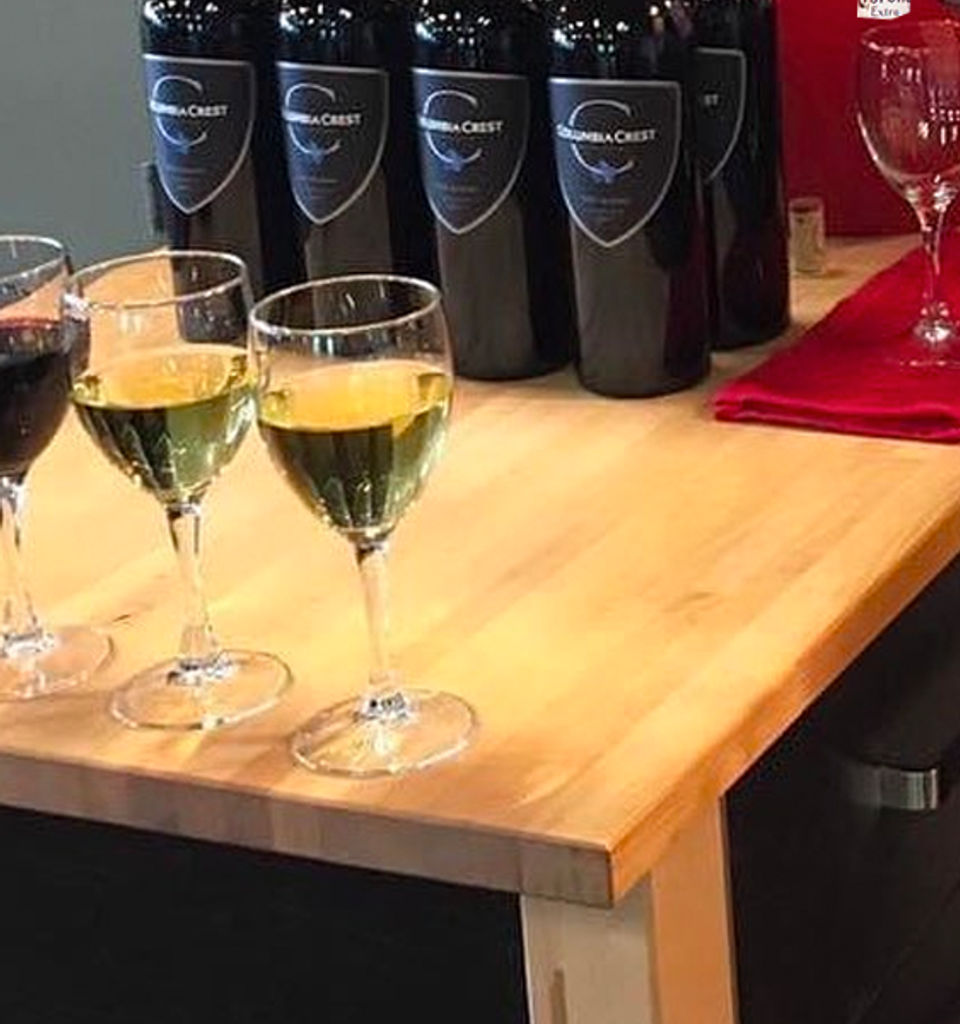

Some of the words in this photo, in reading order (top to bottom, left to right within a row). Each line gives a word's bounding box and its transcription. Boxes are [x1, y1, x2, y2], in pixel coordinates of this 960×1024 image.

[187, 103, 229, 119] CREST
[320, 112, 362, 127] CREST
[460, 119, 504, 135] CREST
[614, 128, 656, 144] CREST
